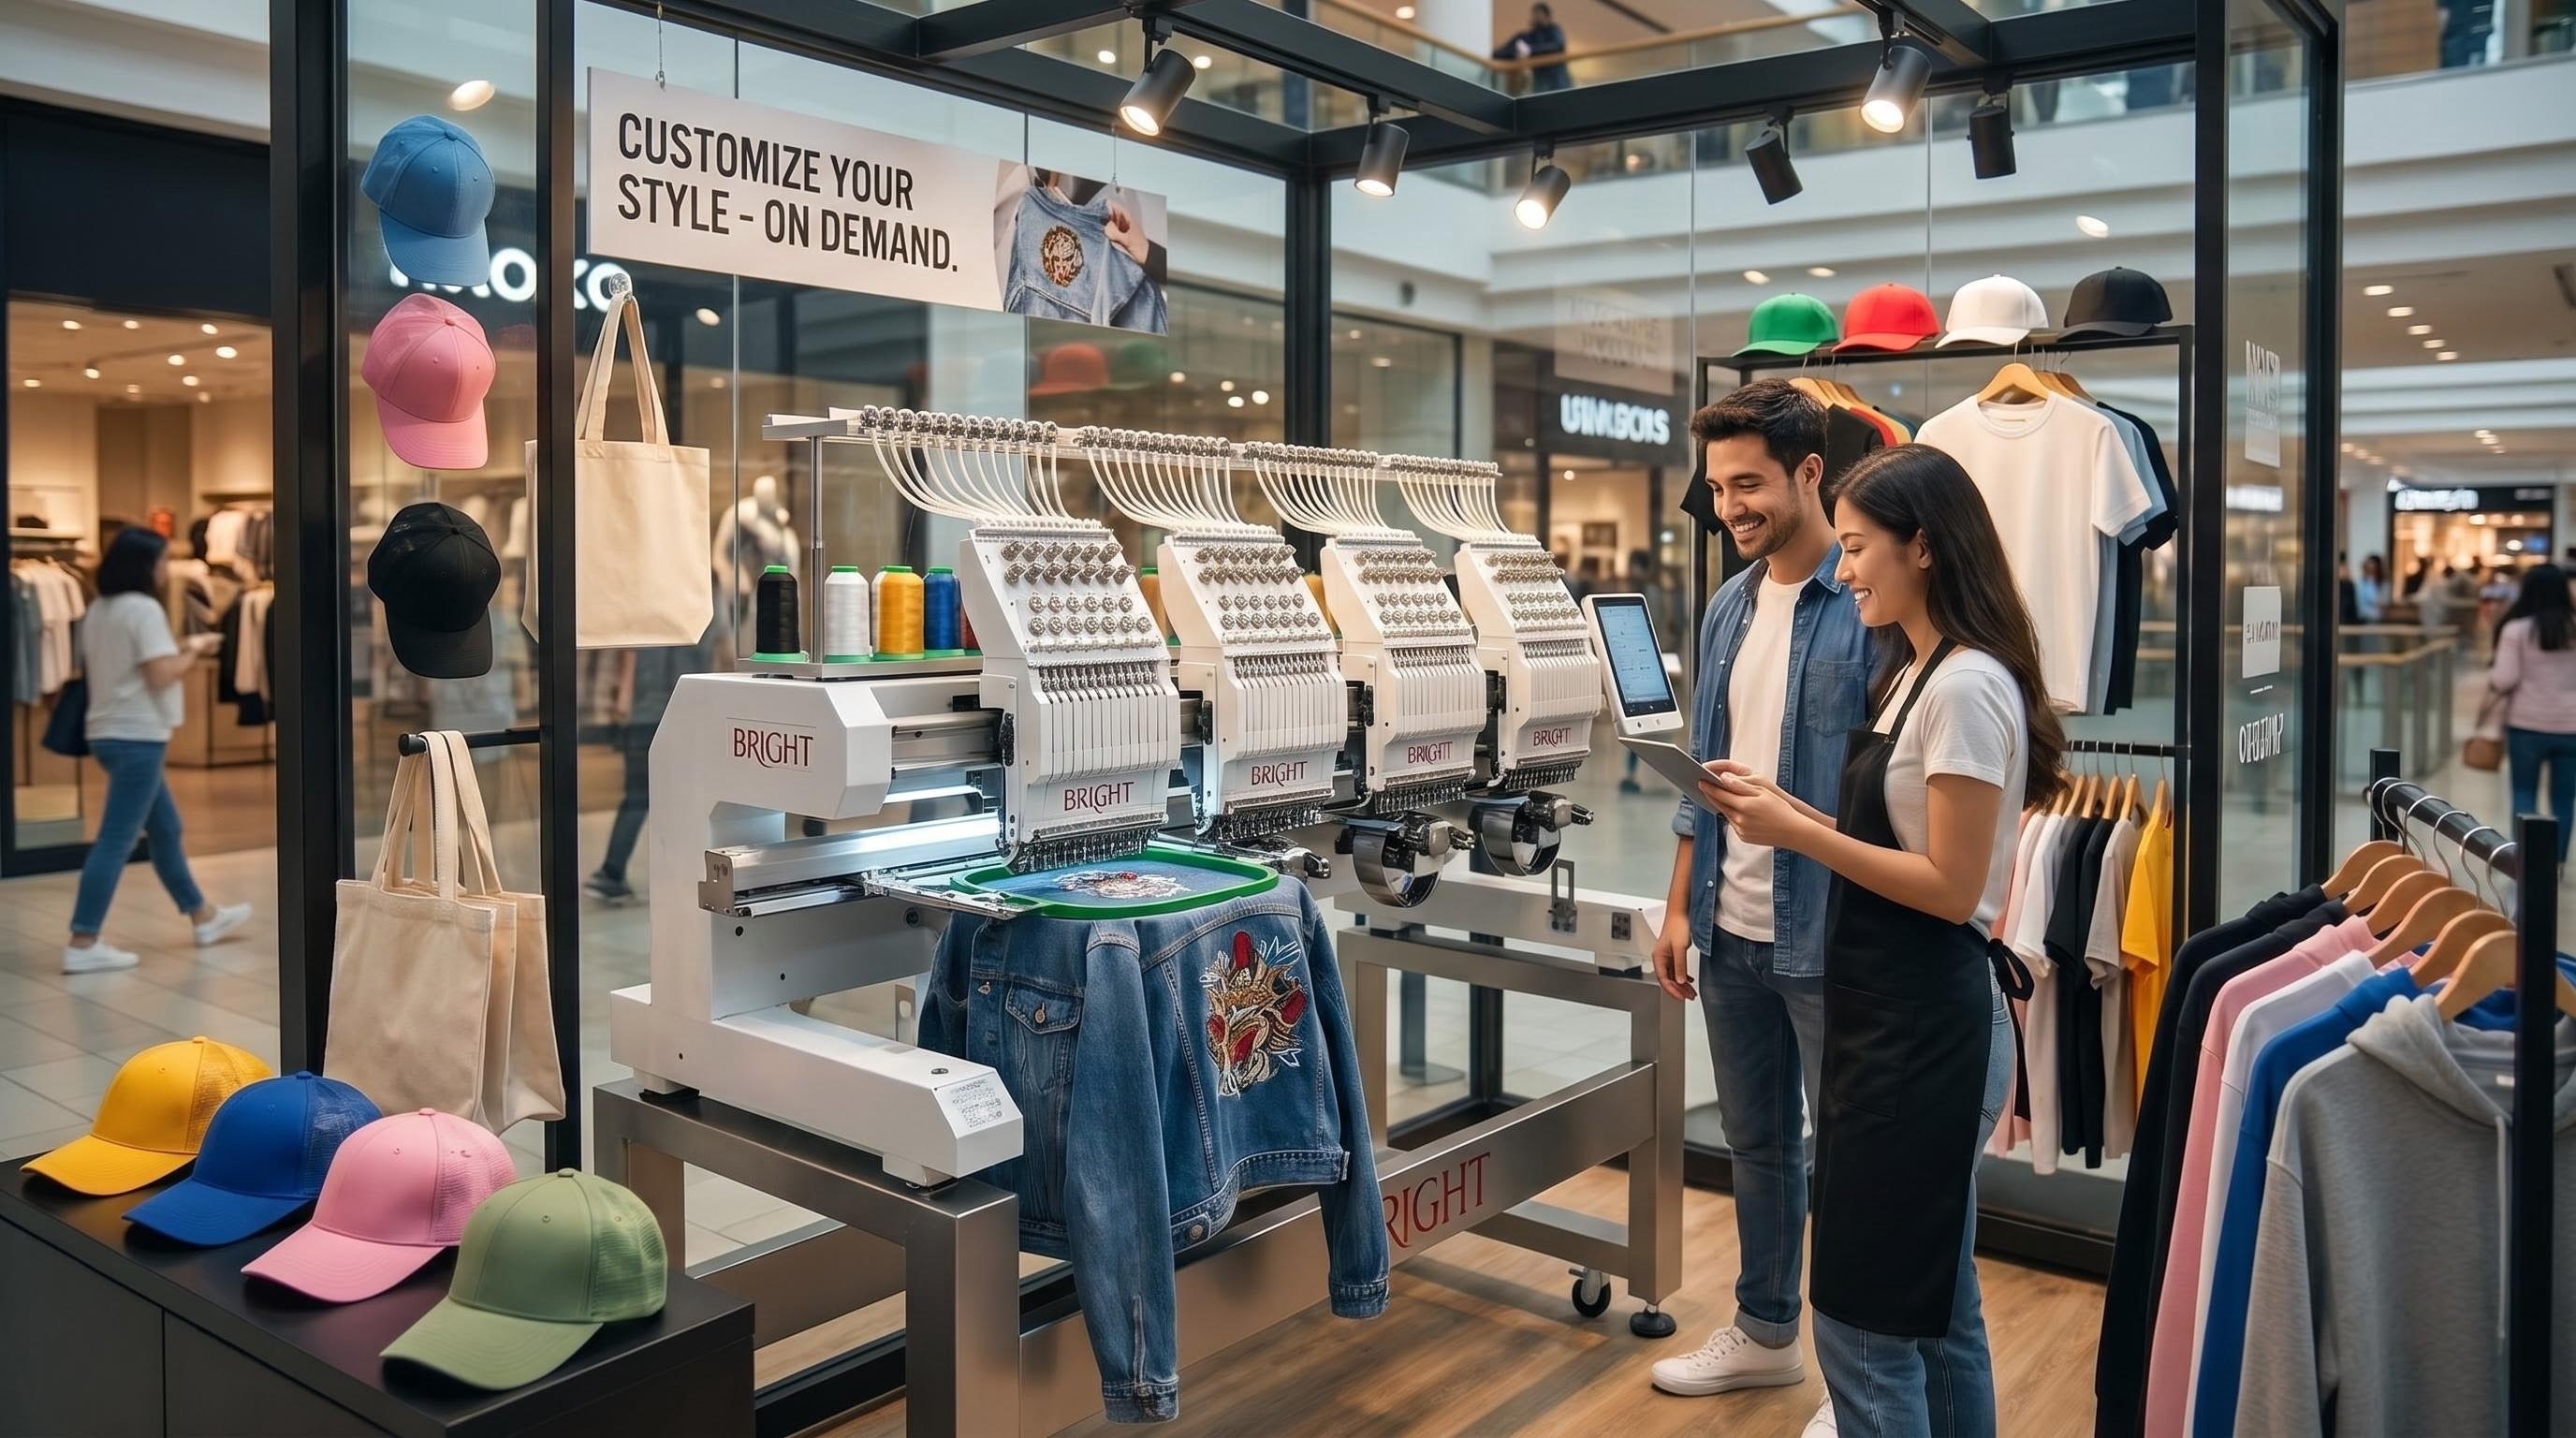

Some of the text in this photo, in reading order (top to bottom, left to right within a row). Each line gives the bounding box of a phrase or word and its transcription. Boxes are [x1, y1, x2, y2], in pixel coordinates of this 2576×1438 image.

[619, 112, 914, 211] CUSTOMIZE YOUR
[618, 174, 730, 235] STYLE
[765, 199, 810, 247] ON
[821, 208, 959, 272] DEMAND.
[734, 727, 814, 769] BRIGHT
[1251, 761, 1308, 787] BRIGHT
[1064, 782, 1134, 814] BRIGHT
[1383, 1152, 1491, 1248] RIGHT
